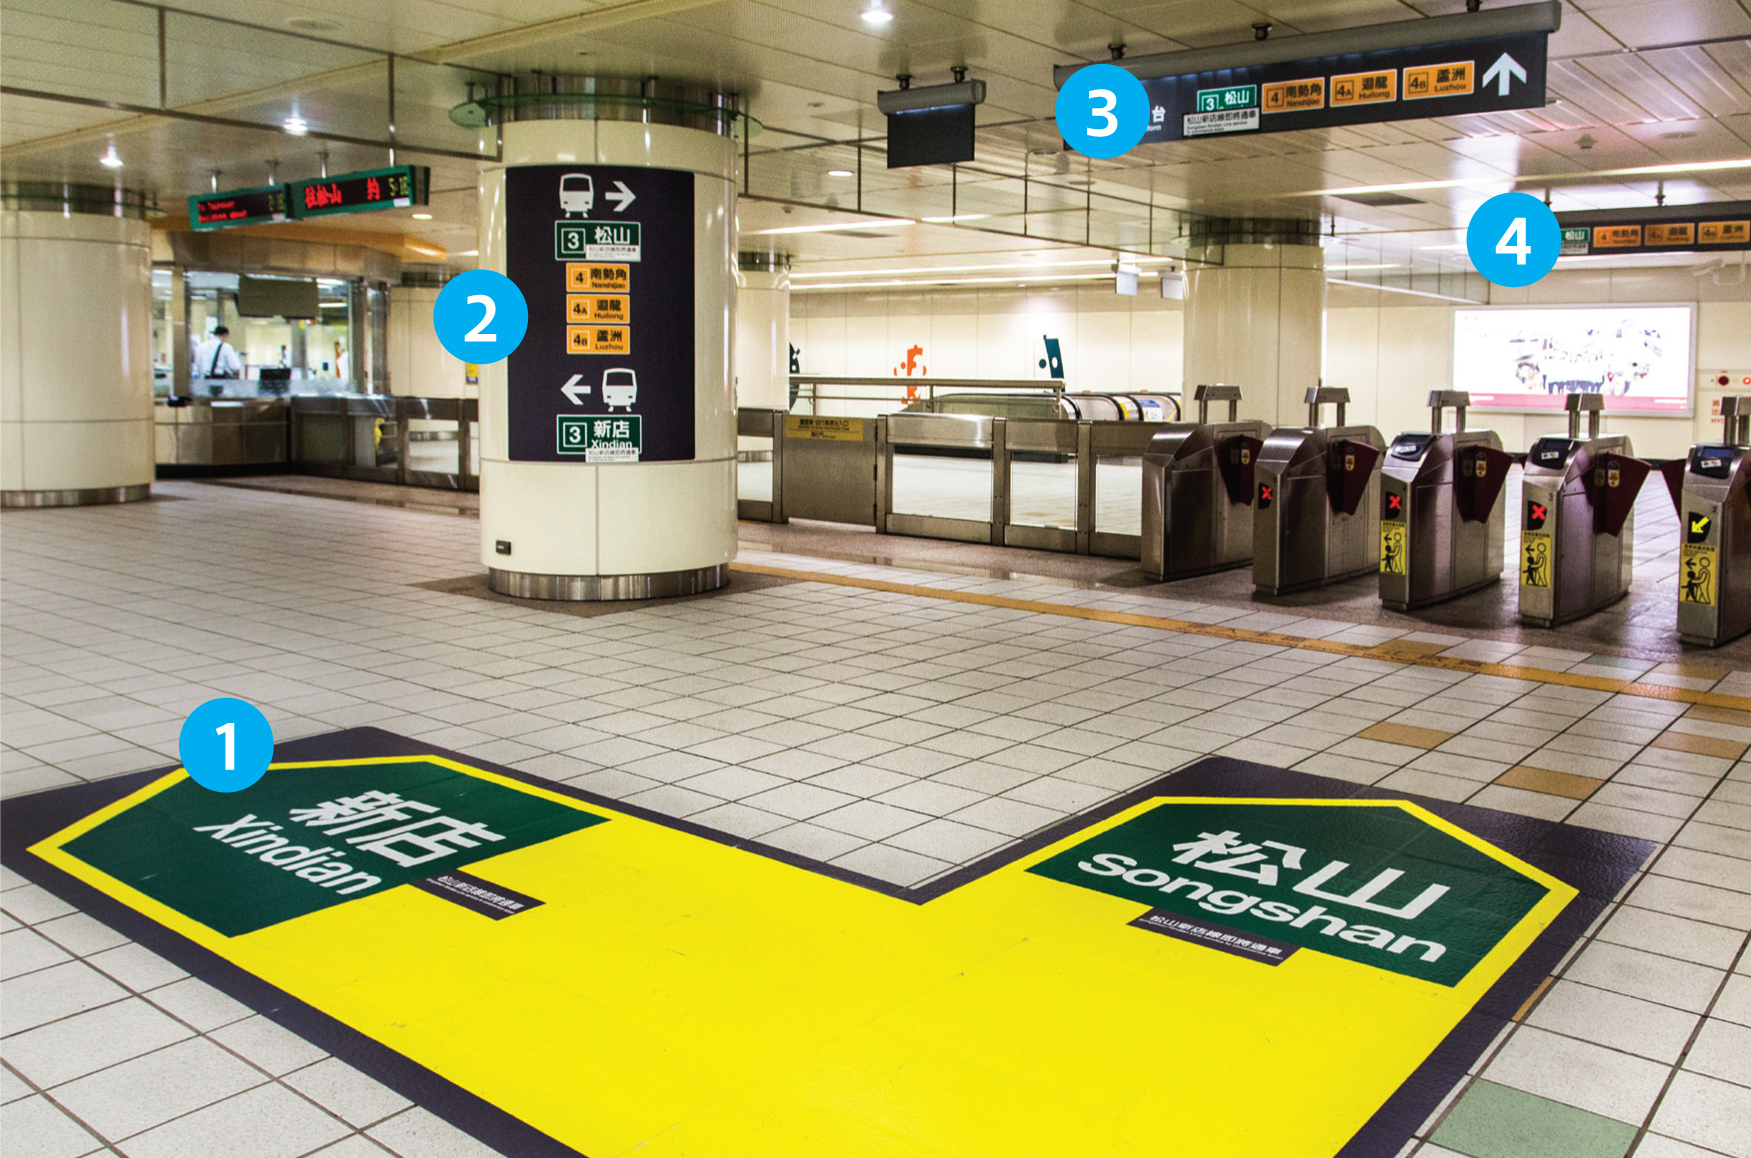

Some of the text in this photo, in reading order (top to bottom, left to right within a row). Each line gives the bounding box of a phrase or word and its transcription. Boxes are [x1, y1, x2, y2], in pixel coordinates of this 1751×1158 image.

[1410, 77, 1426, 90] 4B
[1434, 84, 1467, 93] Luzhou
[1225, 90, 1250, 105] 松山
[1271, 91, 1279, 104] 4
[1337, 85, 1351, 97] 4A
[1359, 90, 1390, 100] Huilong
[1206, 98, 1215, 111] 3
[567, 232, 579, 249] 3
[594, 225, 630, 245] 松山
[576, 272, 584, 283] 4
[573, 303, 587, 315] 4A
[573, 334, 588, 345] 4B
[569, 426, 581, 443] 3
[593, 420, 630, 439] 新店
[591, 439, 633, 449] Xindian
[289, 790, 507, 868] 新店
[192, 813, 382, 895] Xindian
[1171, 830, 1451, 920] 松山
[1077, 852, 1447, 963] Songshan
